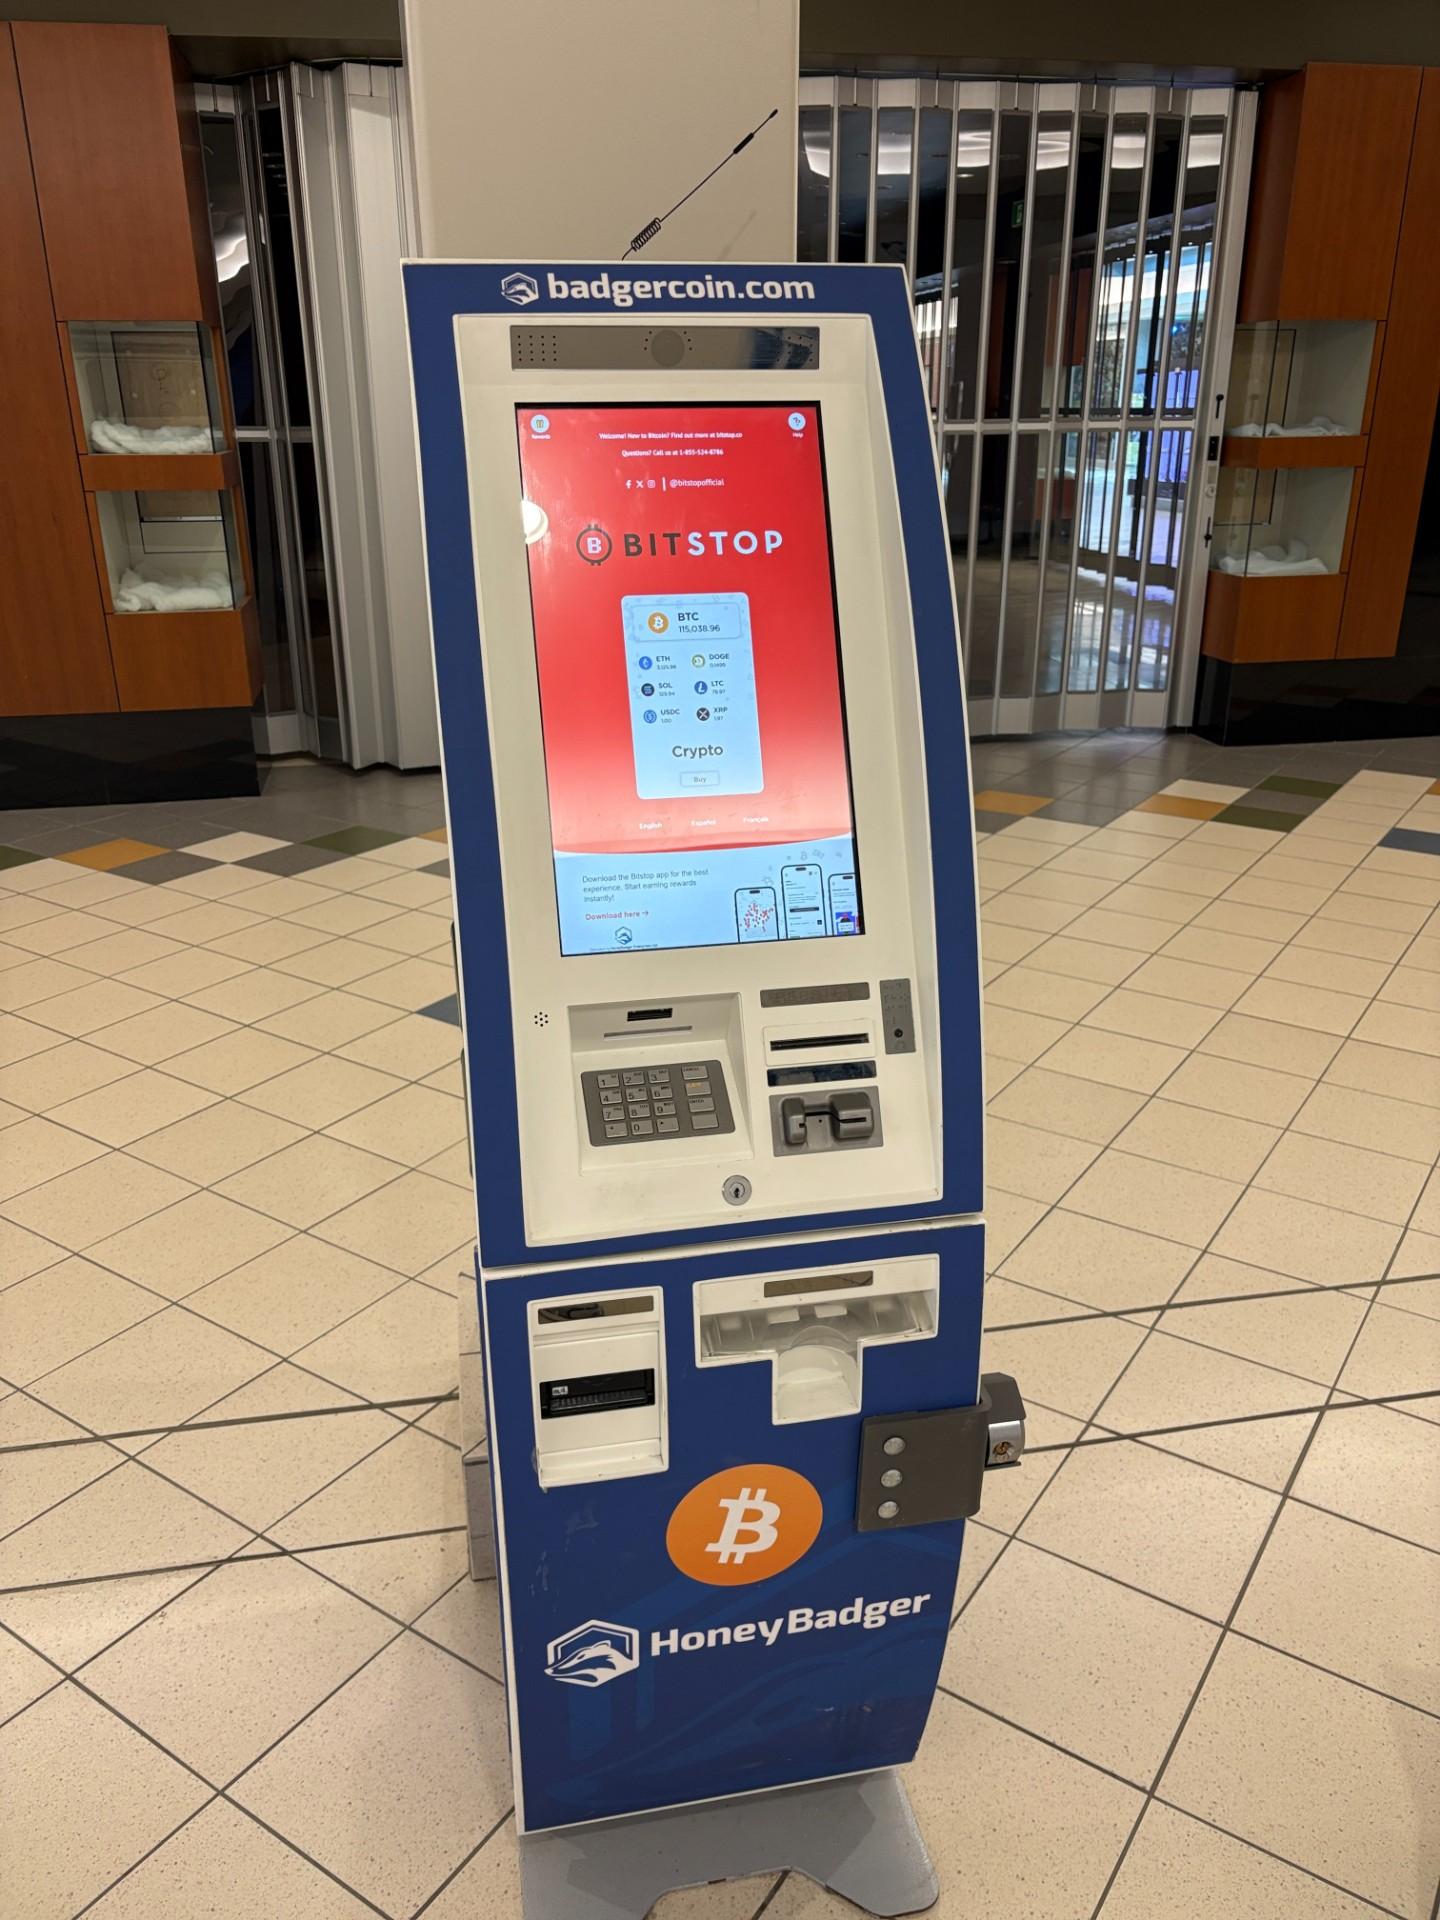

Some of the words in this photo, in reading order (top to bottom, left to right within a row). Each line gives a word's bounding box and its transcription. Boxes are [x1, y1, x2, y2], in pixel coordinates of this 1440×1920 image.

[547, 272, 816, 308] badgercoin.com
[622, 450, 652, 458] Questions?
[670, 478, 725, 488] @bitstopofficial
[623, 530, 783, 557] BITSTOP
[678, 612, 700, 622] BTC
[679, 624, 720, 633] 115,038.96
[672, 744, 724, 760] Crypto
[639, 822, 663, 830] English
[582, 874, 617, 884] Download
[618, 872, 630, 880] the
[630, 871, 655, 880] Bitstop
[656, 872, 670, 880] app
[670, 869, 680, 878] for
[681, 868, 692, 877] the
[694, 868, 709, 876] best
[584, 884, 622, 894] experience.
[624, 880, 642, 890] Start
[643, 880, 668, 890] earning
[670, 878, 696, 888] rewards
[585, 911, 622, 920] Download
[624, 910, 640, 918] here
[651, 1593, 931, 1657] HoneyBadger
